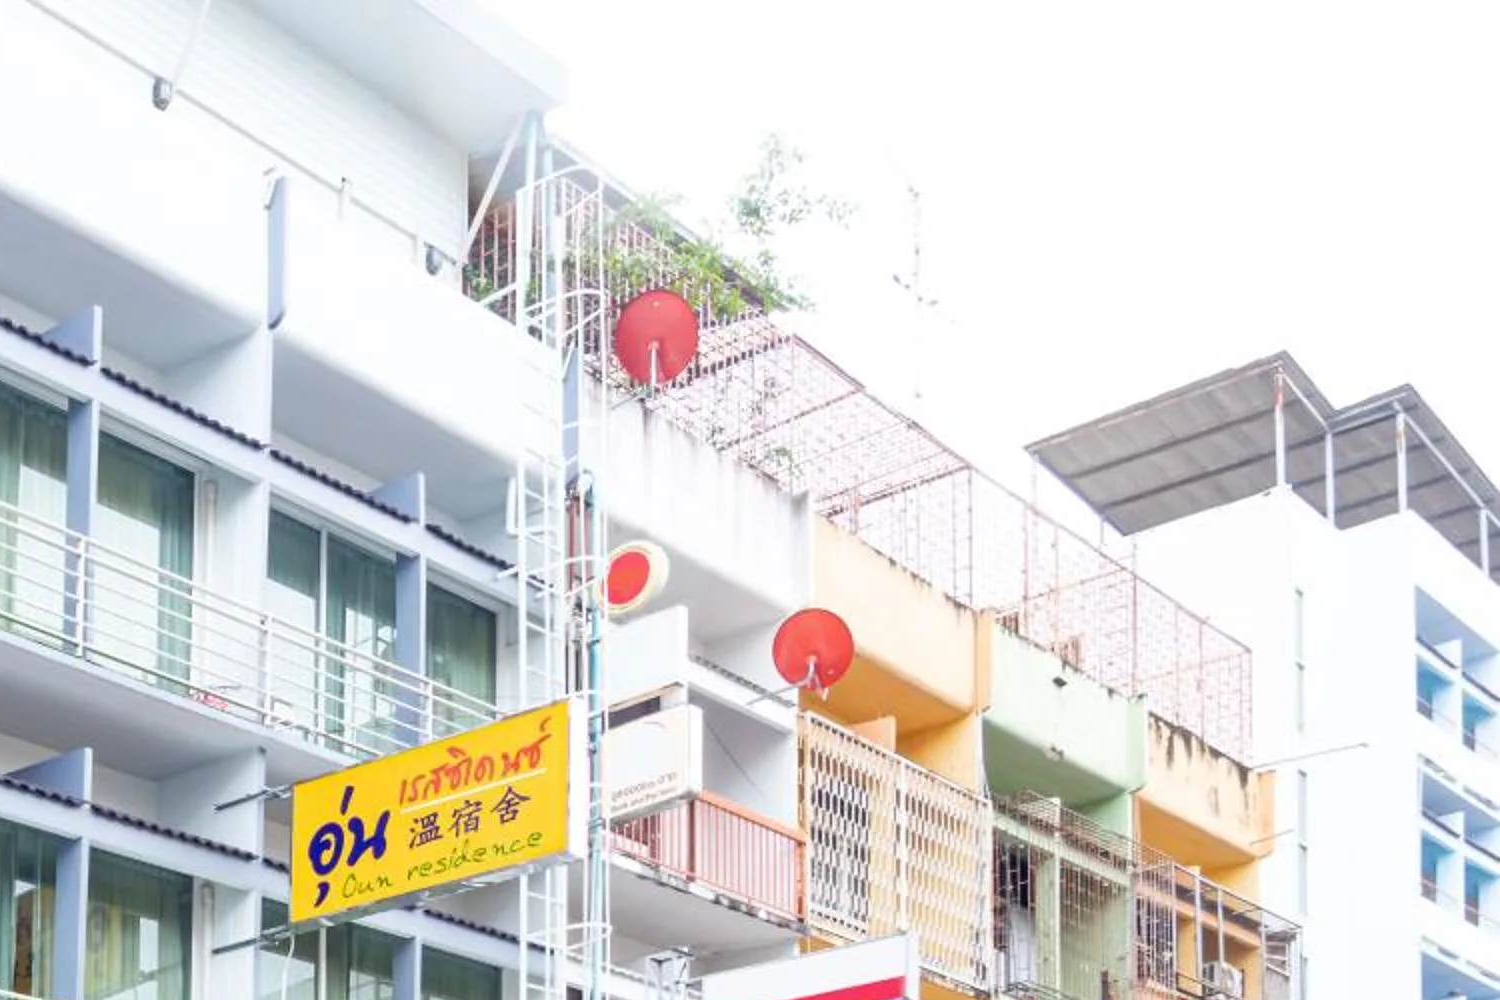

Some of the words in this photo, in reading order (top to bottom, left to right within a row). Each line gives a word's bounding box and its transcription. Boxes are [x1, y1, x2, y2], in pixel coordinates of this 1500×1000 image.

[308, 785, 391, 908] อุ่น
[341, 870, 395, 900] Oun
[406, 830, 544, 881] residence
